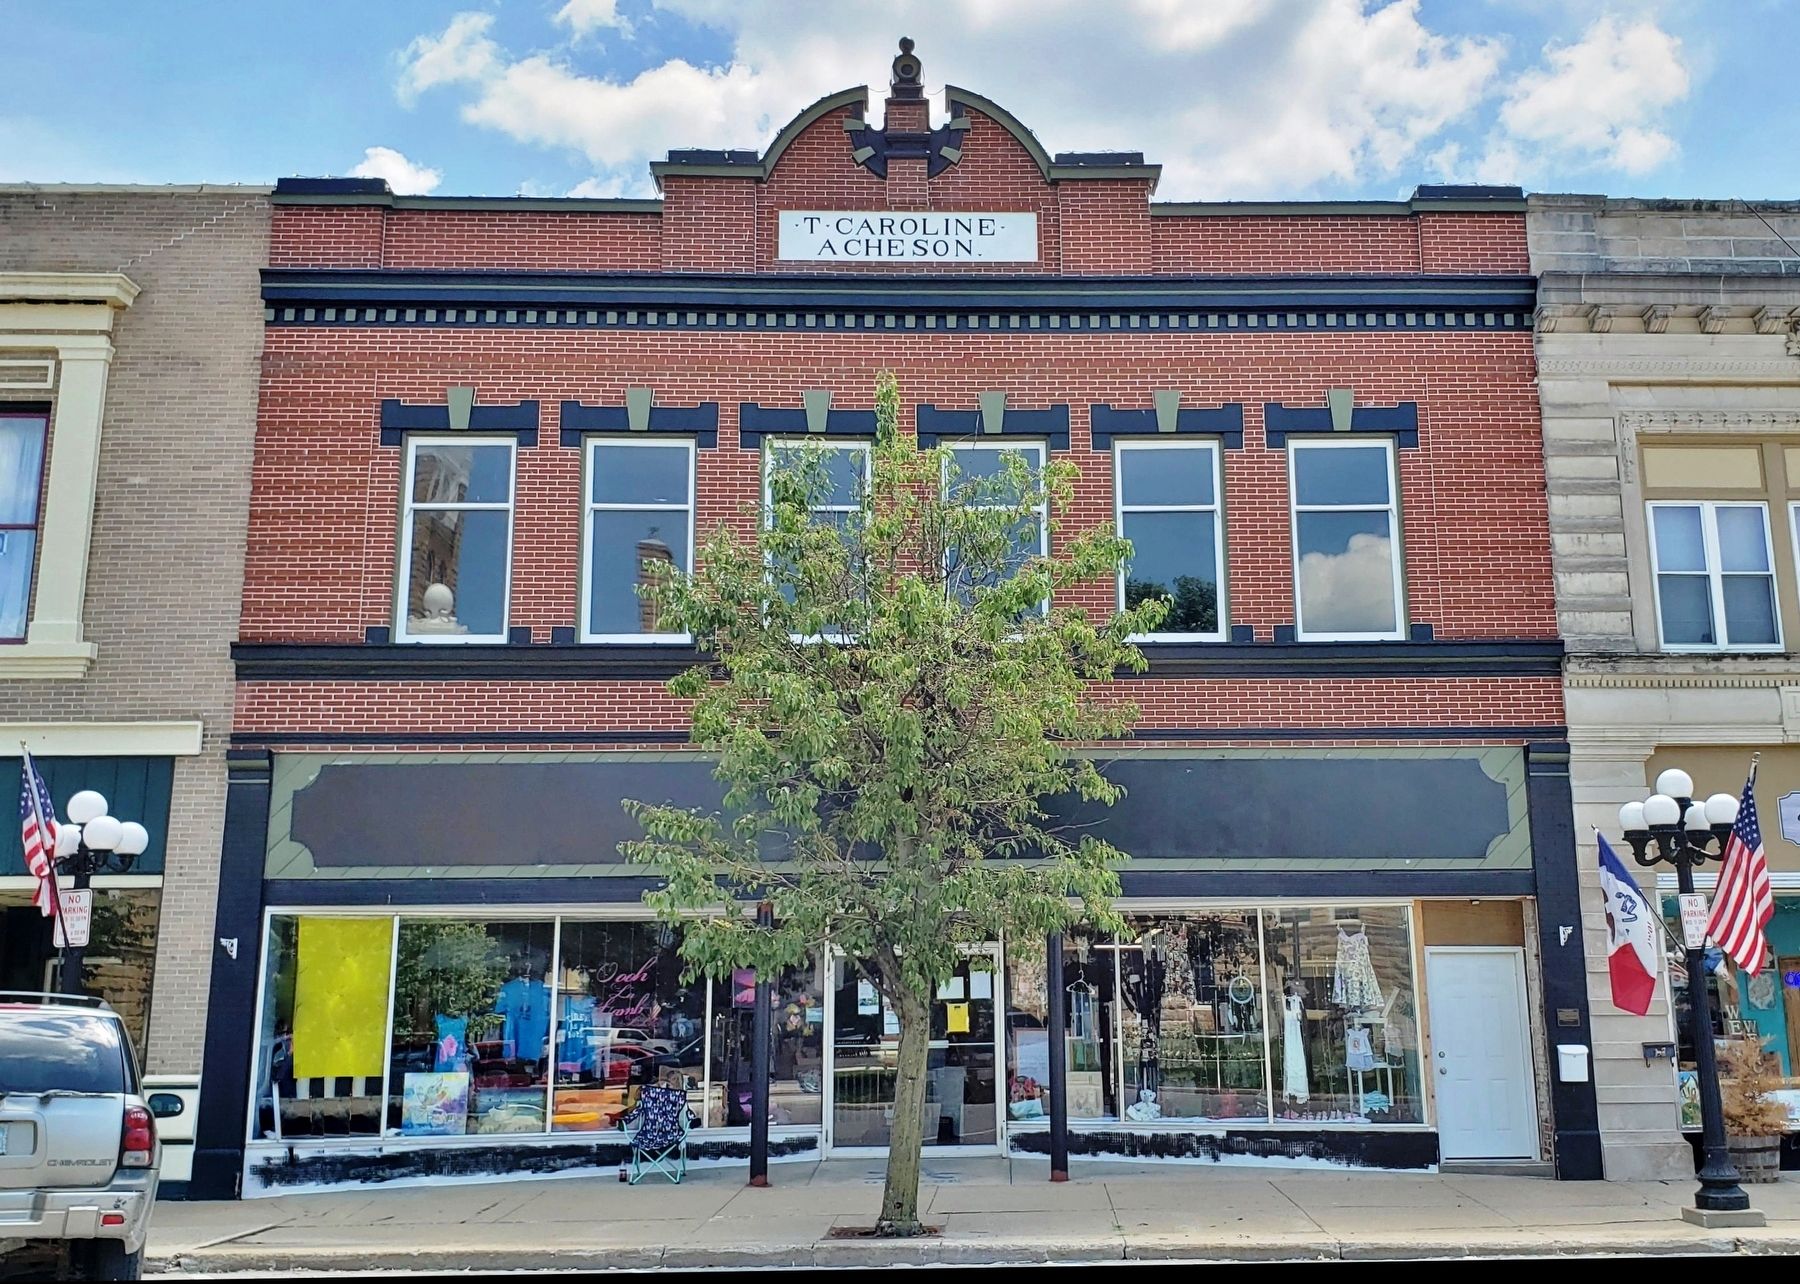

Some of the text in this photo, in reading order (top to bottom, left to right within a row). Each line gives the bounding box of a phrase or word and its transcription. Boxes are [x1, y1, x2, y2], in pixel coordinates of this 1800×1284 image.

[835, 217, 996, 236] CAROLINE
[68, 894, 81, 904] NO
[1687, 898, 1699, 908] NO
[1684, 909, 1706, 918] PARKING
[46, 1159, 114, 1167] CHEVROLET
